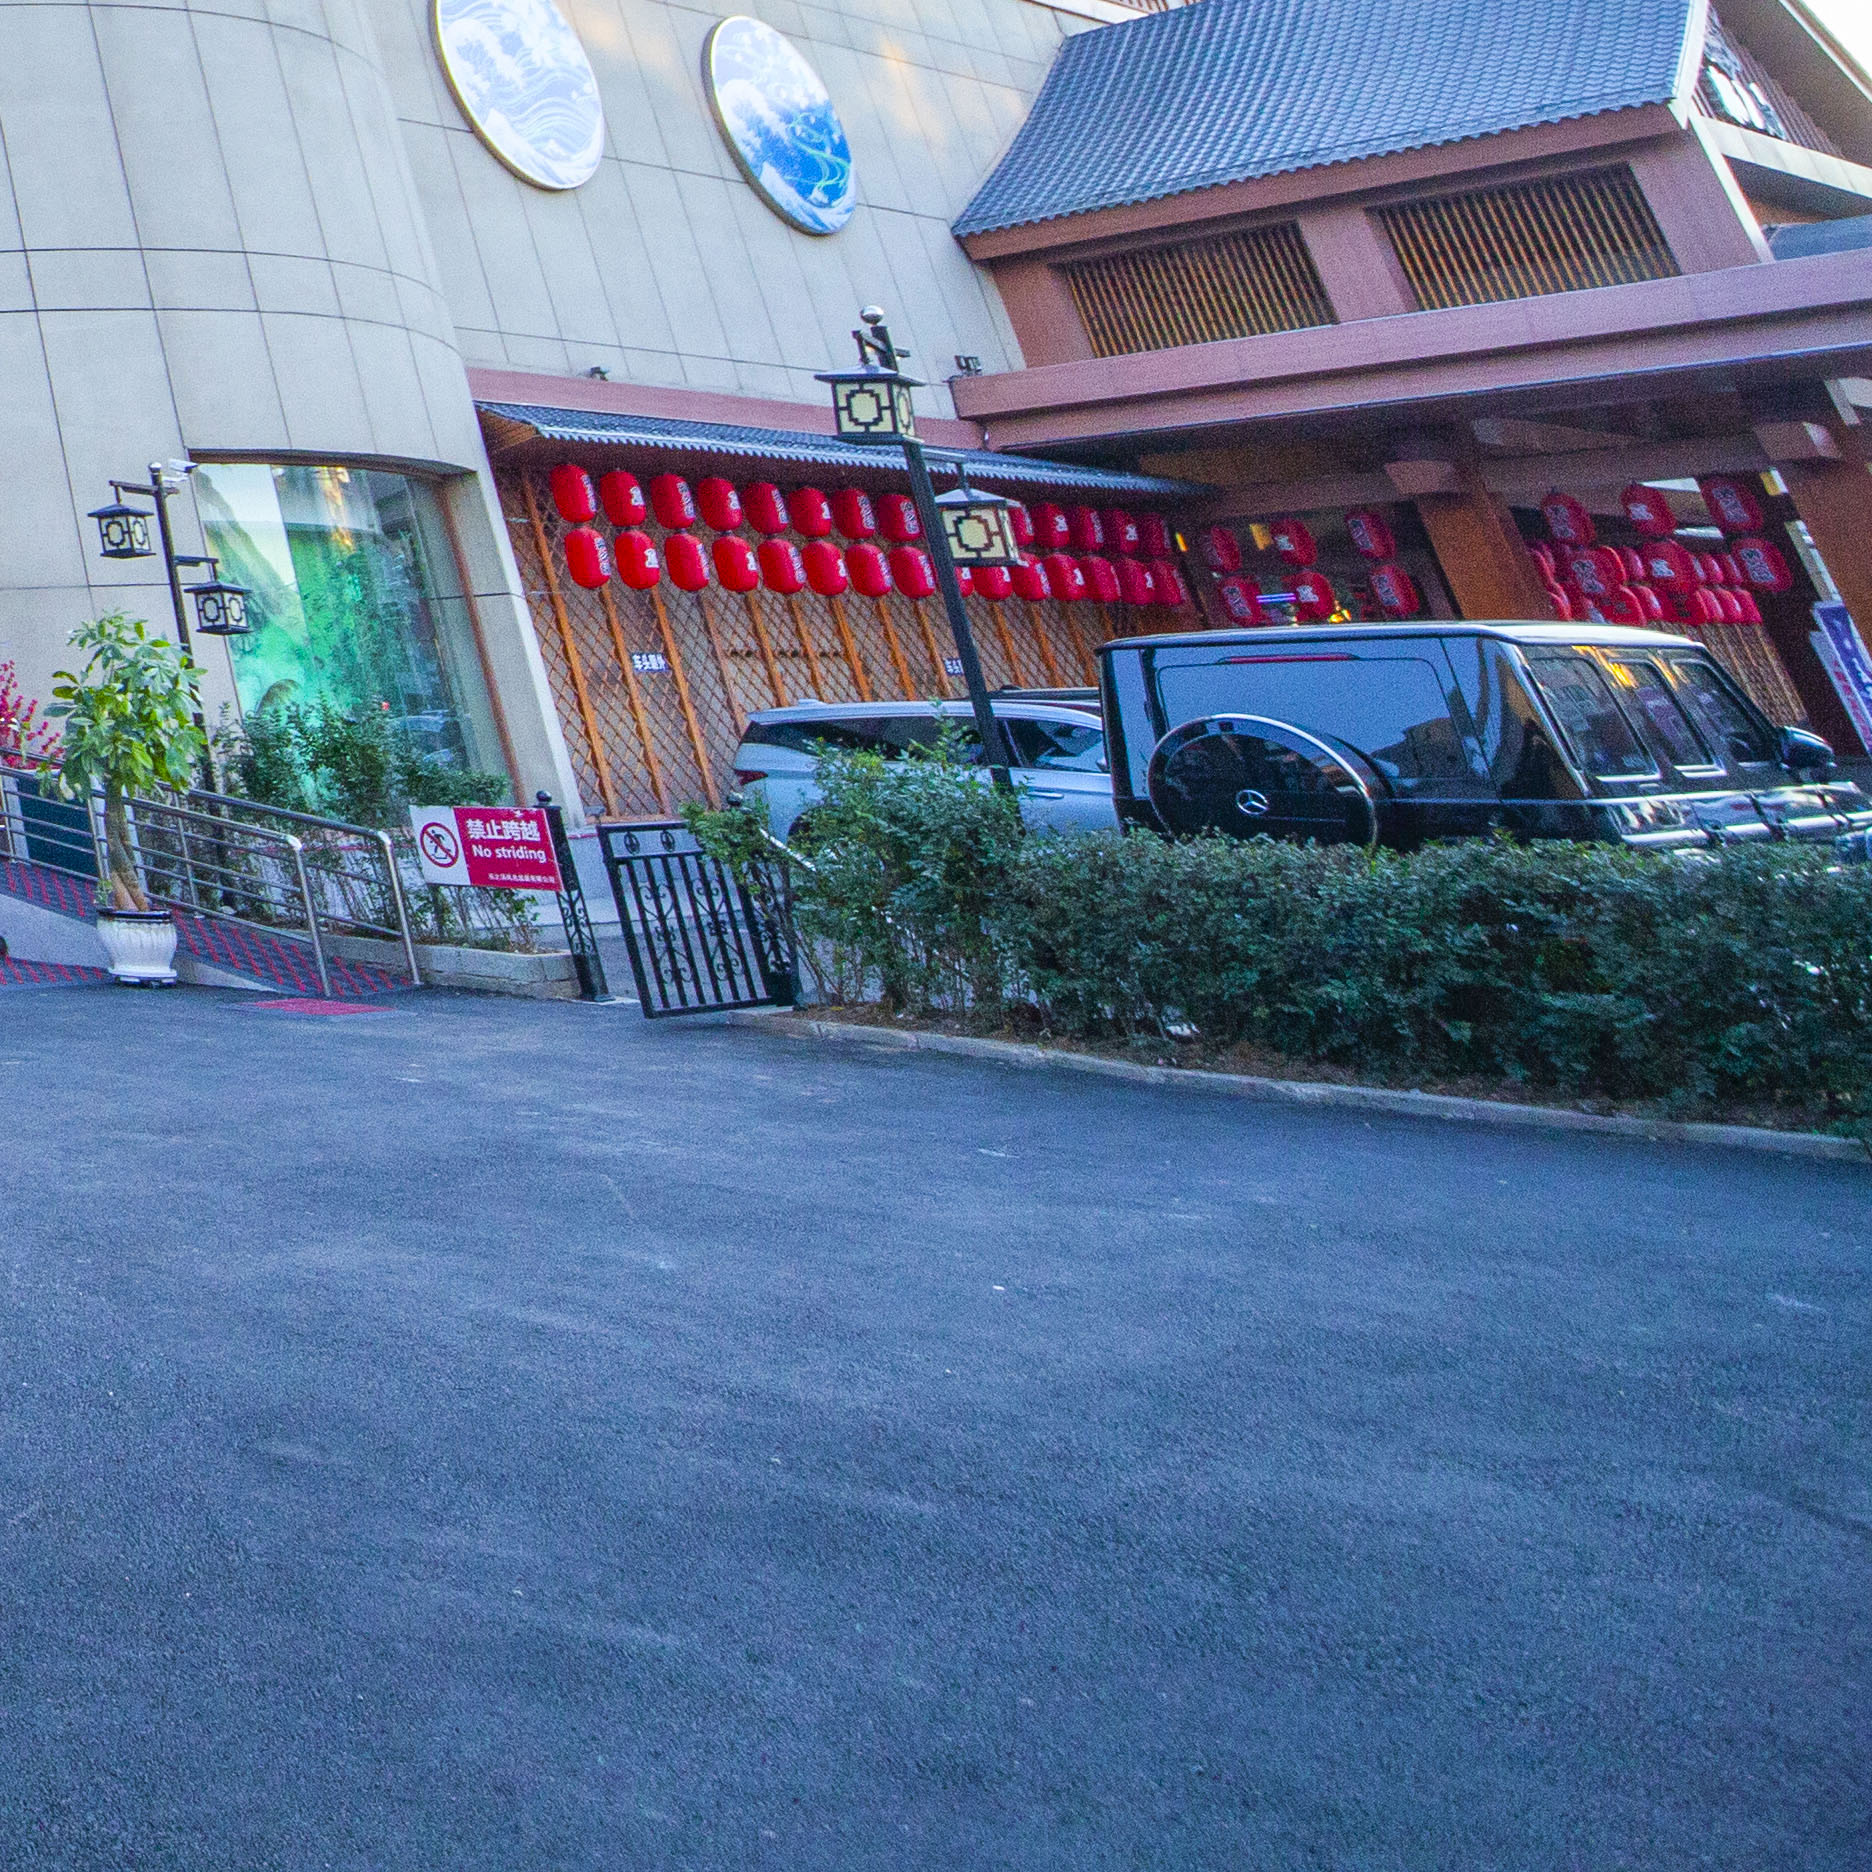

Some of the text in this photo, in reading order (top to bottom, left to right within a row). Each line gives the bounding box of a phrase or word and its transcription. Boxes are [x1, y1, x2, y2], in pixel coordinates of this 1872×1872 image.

[466, 818, 541, 841] 禁止跨越
[471, 844, 547, 863] No striding
